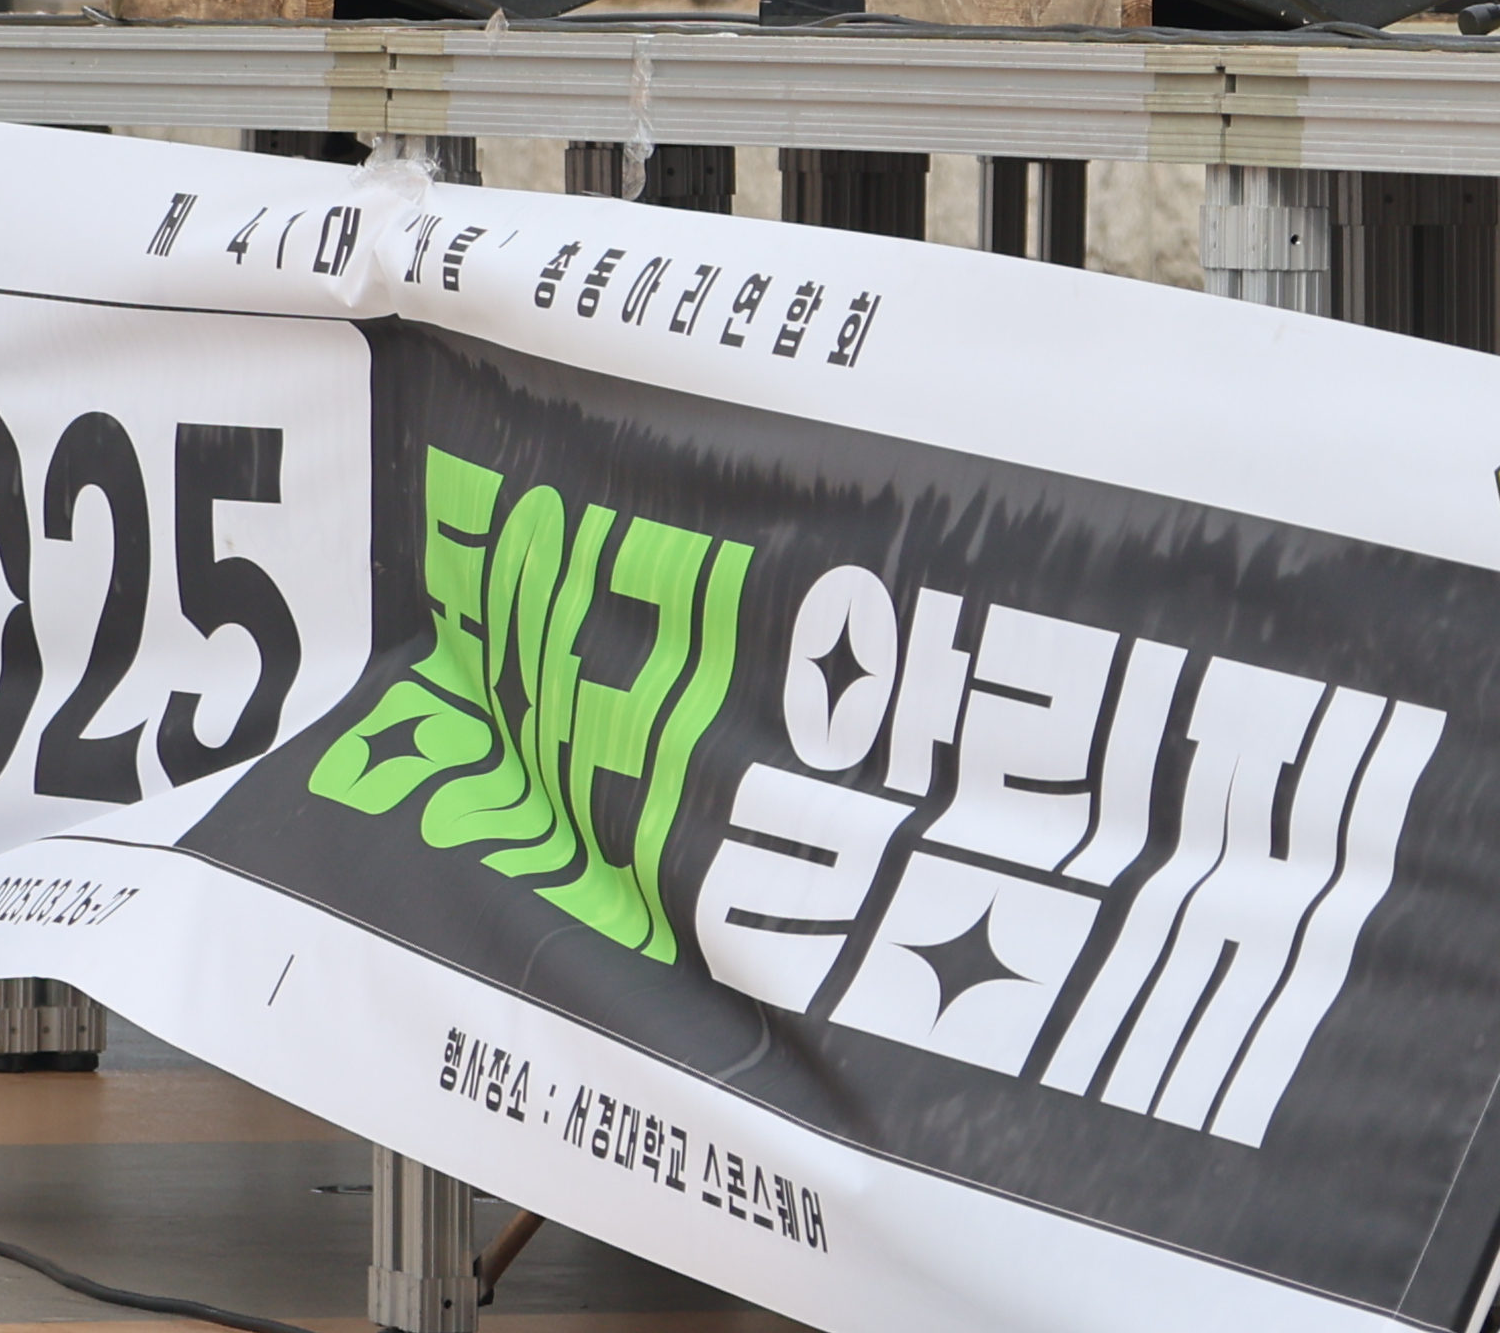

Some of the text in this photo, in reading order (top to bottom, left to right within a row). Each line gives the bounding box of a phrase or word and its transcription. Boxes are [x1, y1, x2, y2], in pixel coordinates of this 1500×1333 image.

[146, 192, 198, 257] 제
[226, 206, 362, 278] 41대
[534, 240, 883, 369] 총동아리연합회
[308, 444, 756, 965] 동아리
[695, 564, 1448, 1149] 알림제
[440, 1026, 531, 1123] 행사장소
[562, 1084, 688, 1193] 서경대학교
[701, 1142, 829, 1254] 스콘스퀘어
